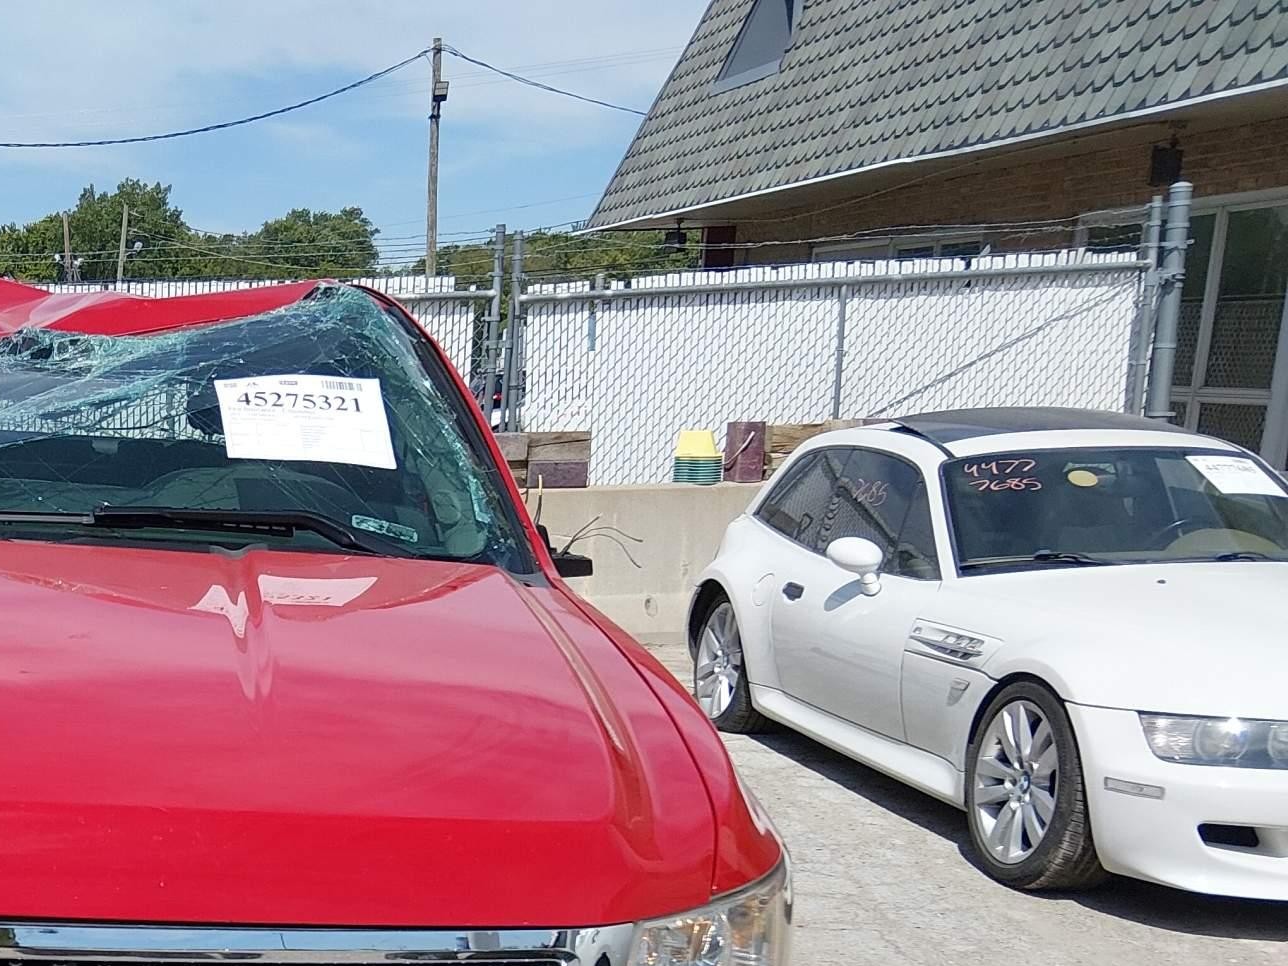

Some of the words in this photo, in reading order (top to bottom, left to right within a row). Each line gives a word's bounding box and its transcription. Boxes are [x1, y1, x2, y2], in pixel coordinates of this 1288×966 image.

[237, 391, 362, 413] 45275321
[964, 459, 1036, 477] 4477
[969, 477, 1042, 491] 7685
